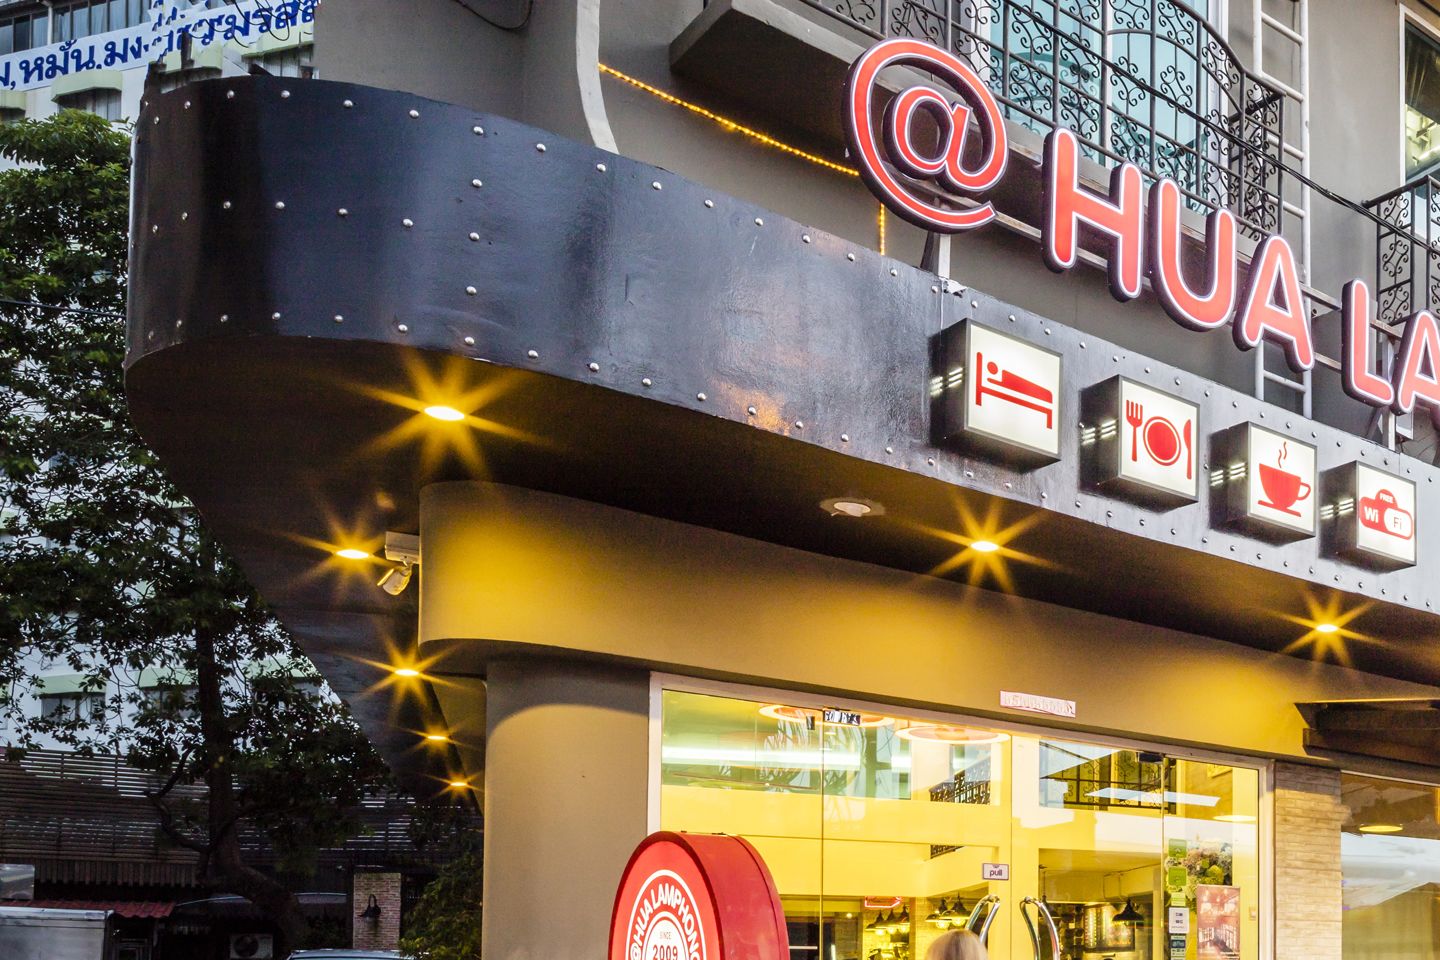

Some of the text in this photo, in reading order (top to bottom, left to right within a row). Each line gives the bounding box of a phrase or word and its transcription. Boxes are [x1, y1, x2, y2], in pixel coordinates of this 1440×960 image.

[845, 37, 1008, 234] @
[1042, 127, 1314, 373] HUA
[989, 869, 1003, 877] pull
